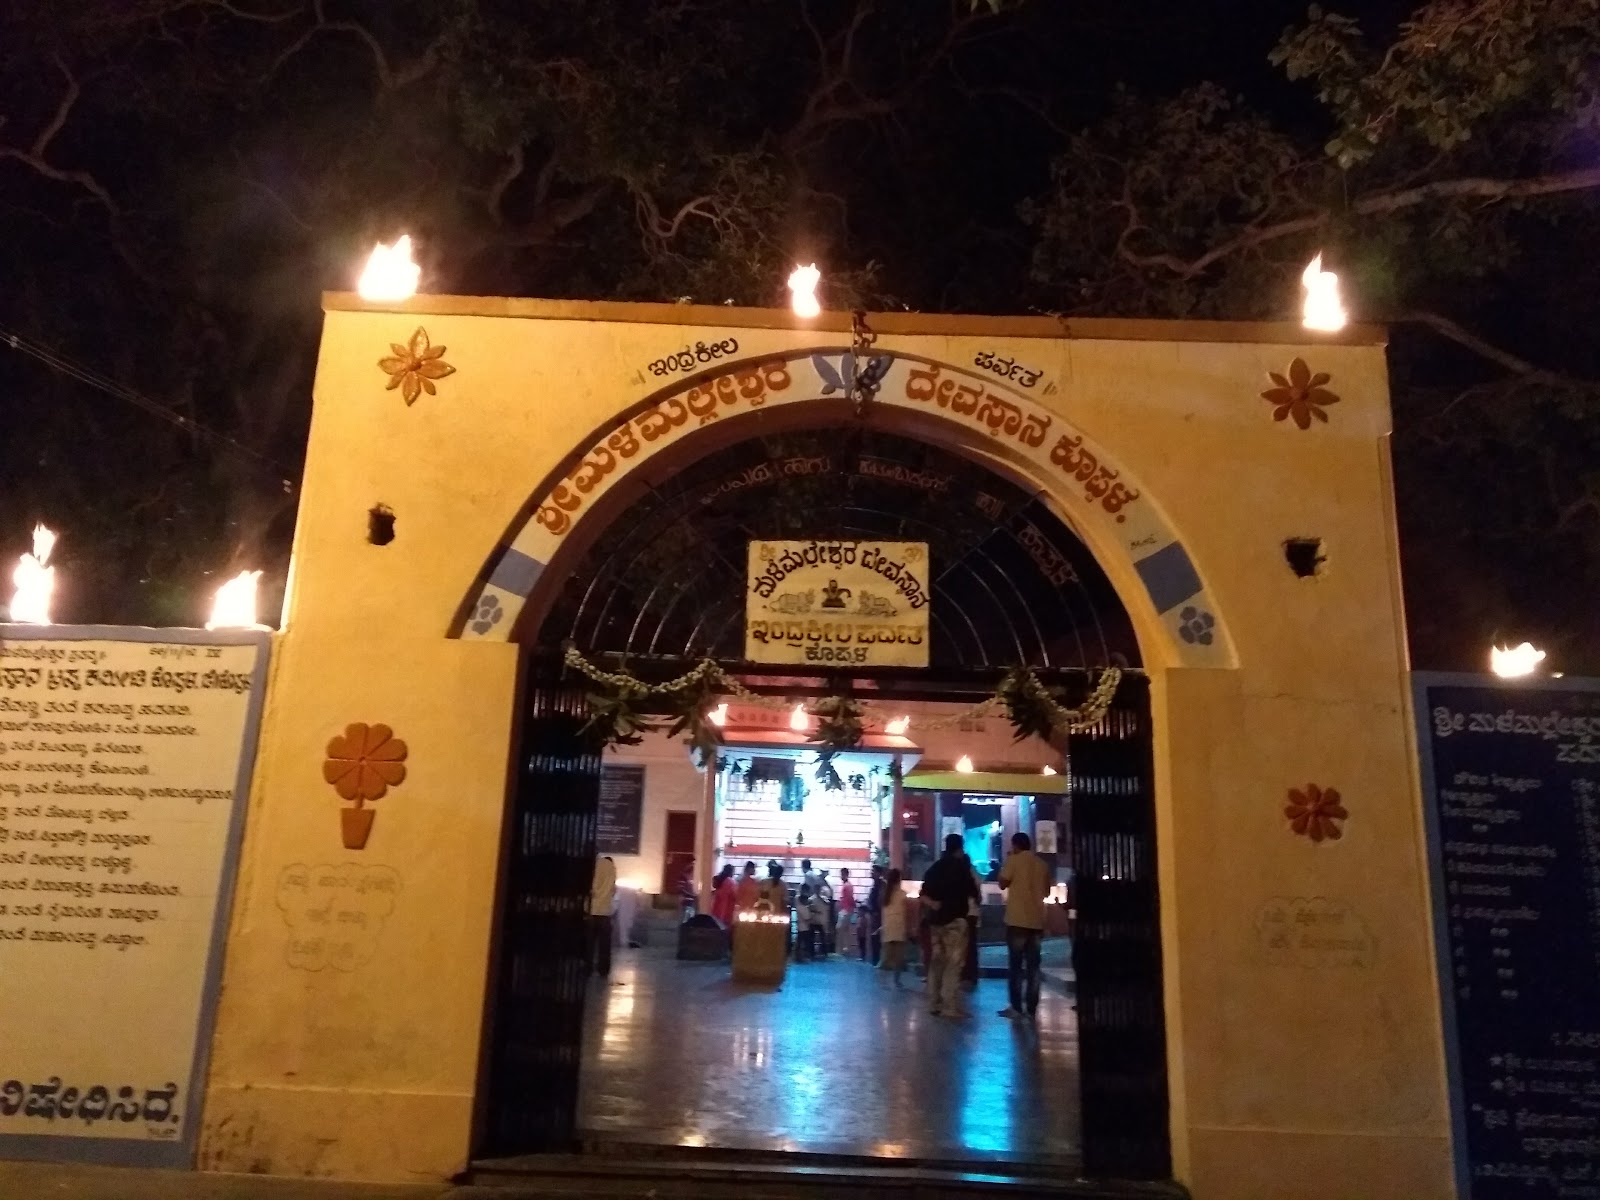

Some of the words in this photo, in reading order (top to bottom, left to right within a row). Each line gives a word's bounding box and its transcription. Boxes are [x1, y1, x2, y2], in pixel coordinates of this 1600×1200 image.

[648, 338, 739, 376] ಇಂದ್ರಕೀಲ
[974, 351, 1044, 389] ಪರ್ವತ
[906, 365, 1053, 448] ದೇವಸ್ಥಾನ
